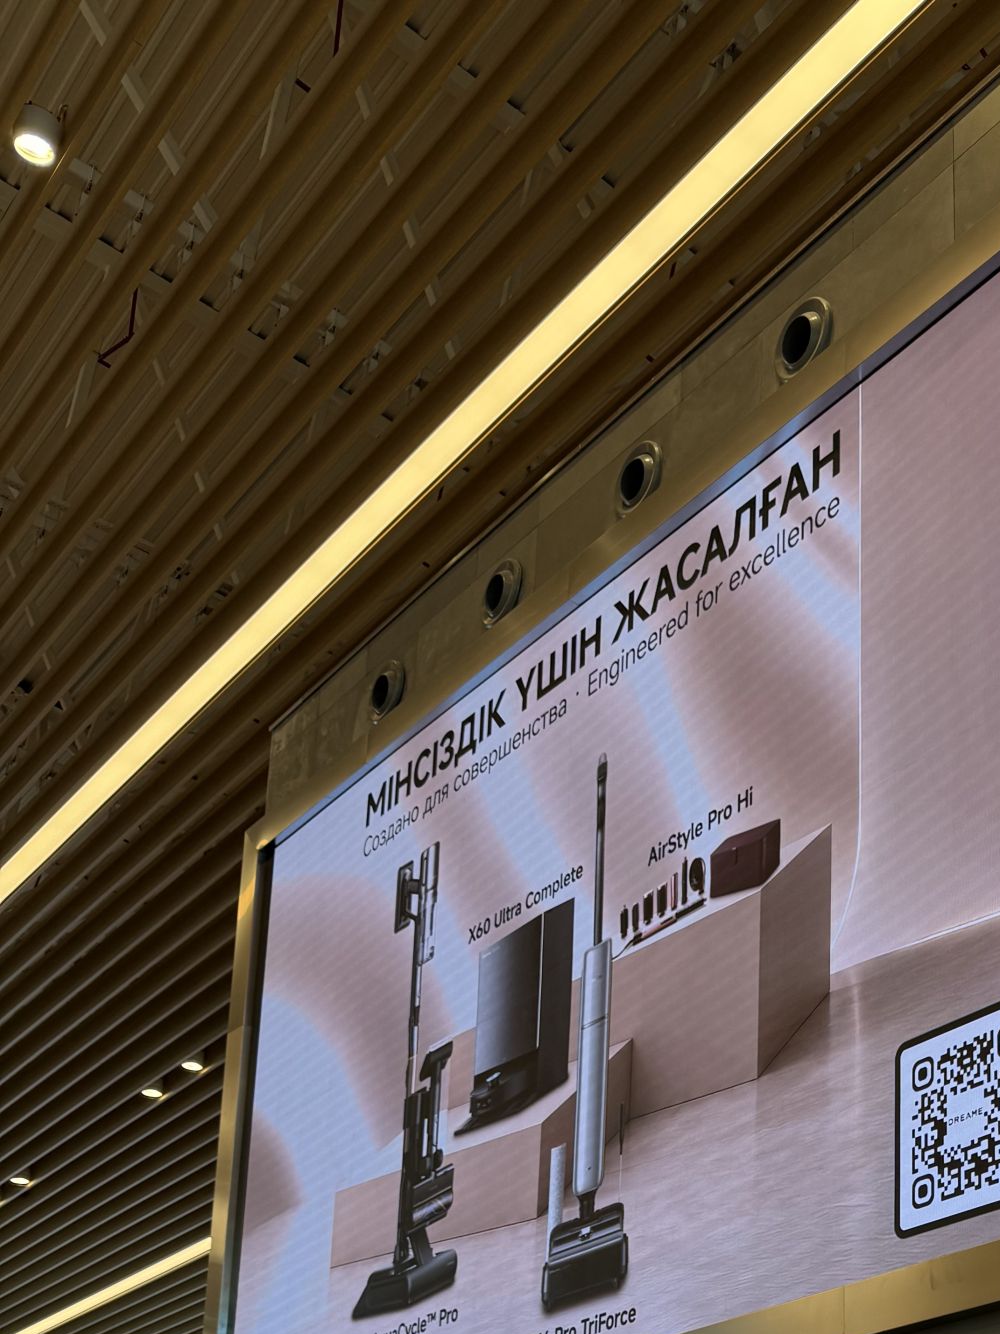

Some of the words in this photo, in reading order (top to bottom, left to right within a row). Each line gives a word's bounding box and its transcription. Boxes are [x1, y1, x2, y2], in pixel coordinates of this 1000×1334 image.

[365, 688, 507, 828] МІНСІЗДІК
[515, 615, 602, 712] ҮШІН
[611, 429, 841, 646] ЖАСАЛҒАН
[363, 806, 419, 857] Создано
[423, 784, 449, 819] для
[454, 699, 567, 791] совершенства
[588, 602, 689, 697] Engineered
[696, 581, 724, 618] for
[729, 496, 840, 591] excellence
[648, 822, 703, 866] AirStyle
[708, 804, 732, 830] Pro
[737, 786, 753, 812] Hi
[468, 917, 491, 945] X60
[494, 901, 521, 929] Ultra
[526, 864, 583, 910] Complete
[948, 1107, 984, 1126] DREAME
[439, 1307, 458, 1327] Pro
